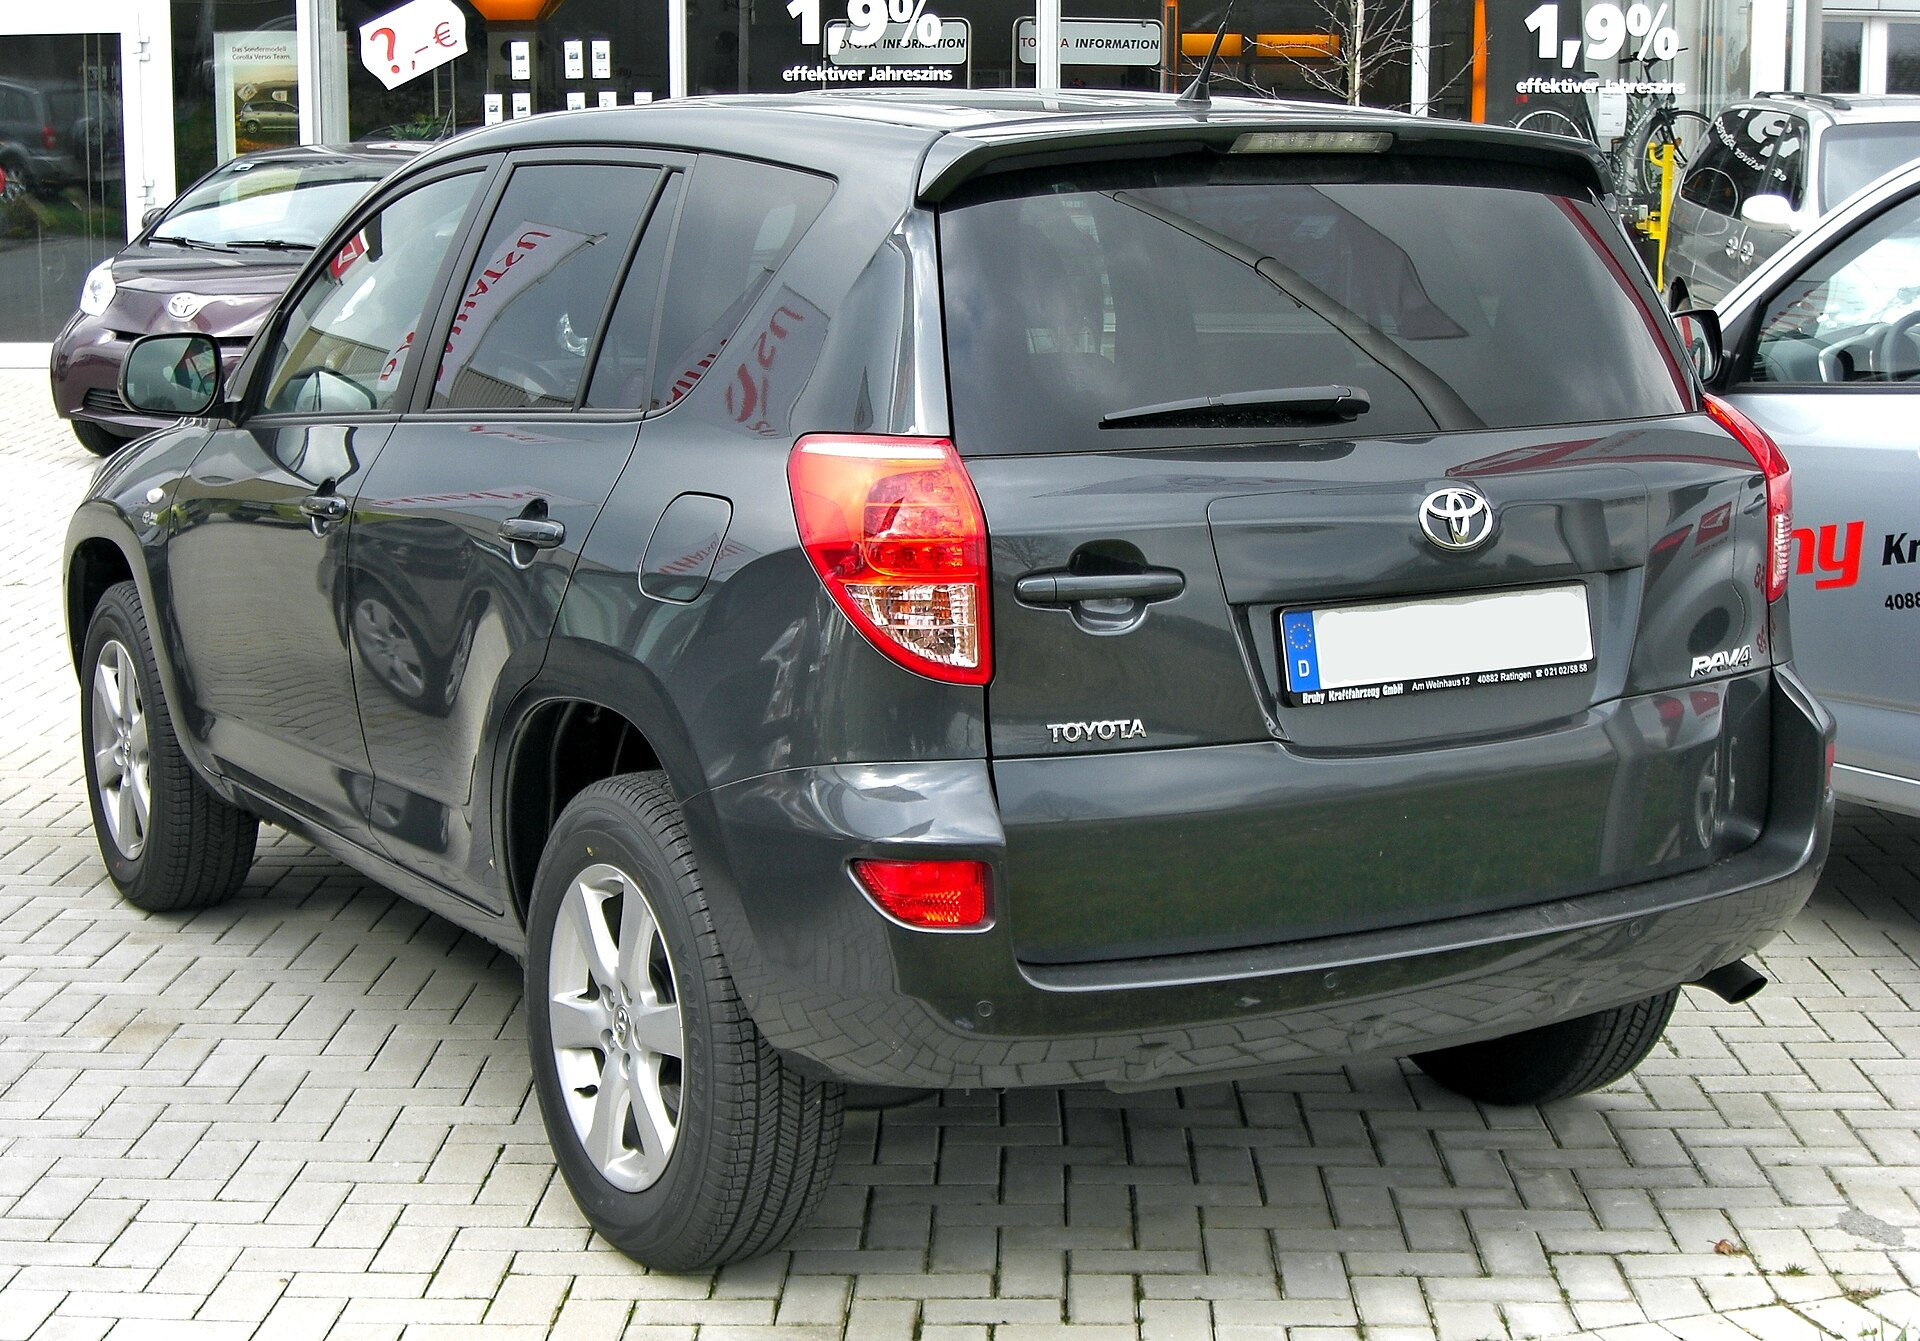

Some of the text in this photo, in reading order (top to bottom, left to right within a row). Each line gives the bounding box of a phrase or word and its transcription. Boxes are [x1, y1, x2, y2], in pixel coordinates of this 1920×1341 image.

[786, 0, 942, 55] 1,9%
[1524, 3, 1679, 68] 1,9%
[1075, 39, 1159, 49] INFORMATION
[782, 66, 953, 82] effektiver Jahreszins
[1516, 78, 1686, 95] effektiver Jahreszins
[1298, 659, 1310, 677] D
[1690, 644, 1753, 679] RAV4
[1302, 692, 1325, 704] Bruhy
[1328, 686, 1380, 702] Kraftfahrzeug
[1382, 683, 1404, 696] GmbH
[1411, 681, 1425, 691] Am
[1425, 678, 1461, 690] Weinhaus
[1461, 676, 1471, 686] 12
[1477, 674, 1499, 684] 40882
[1500, 671, 1532, 682] Ratingen
[1046, 719, 1147, 743] TOYOTA
